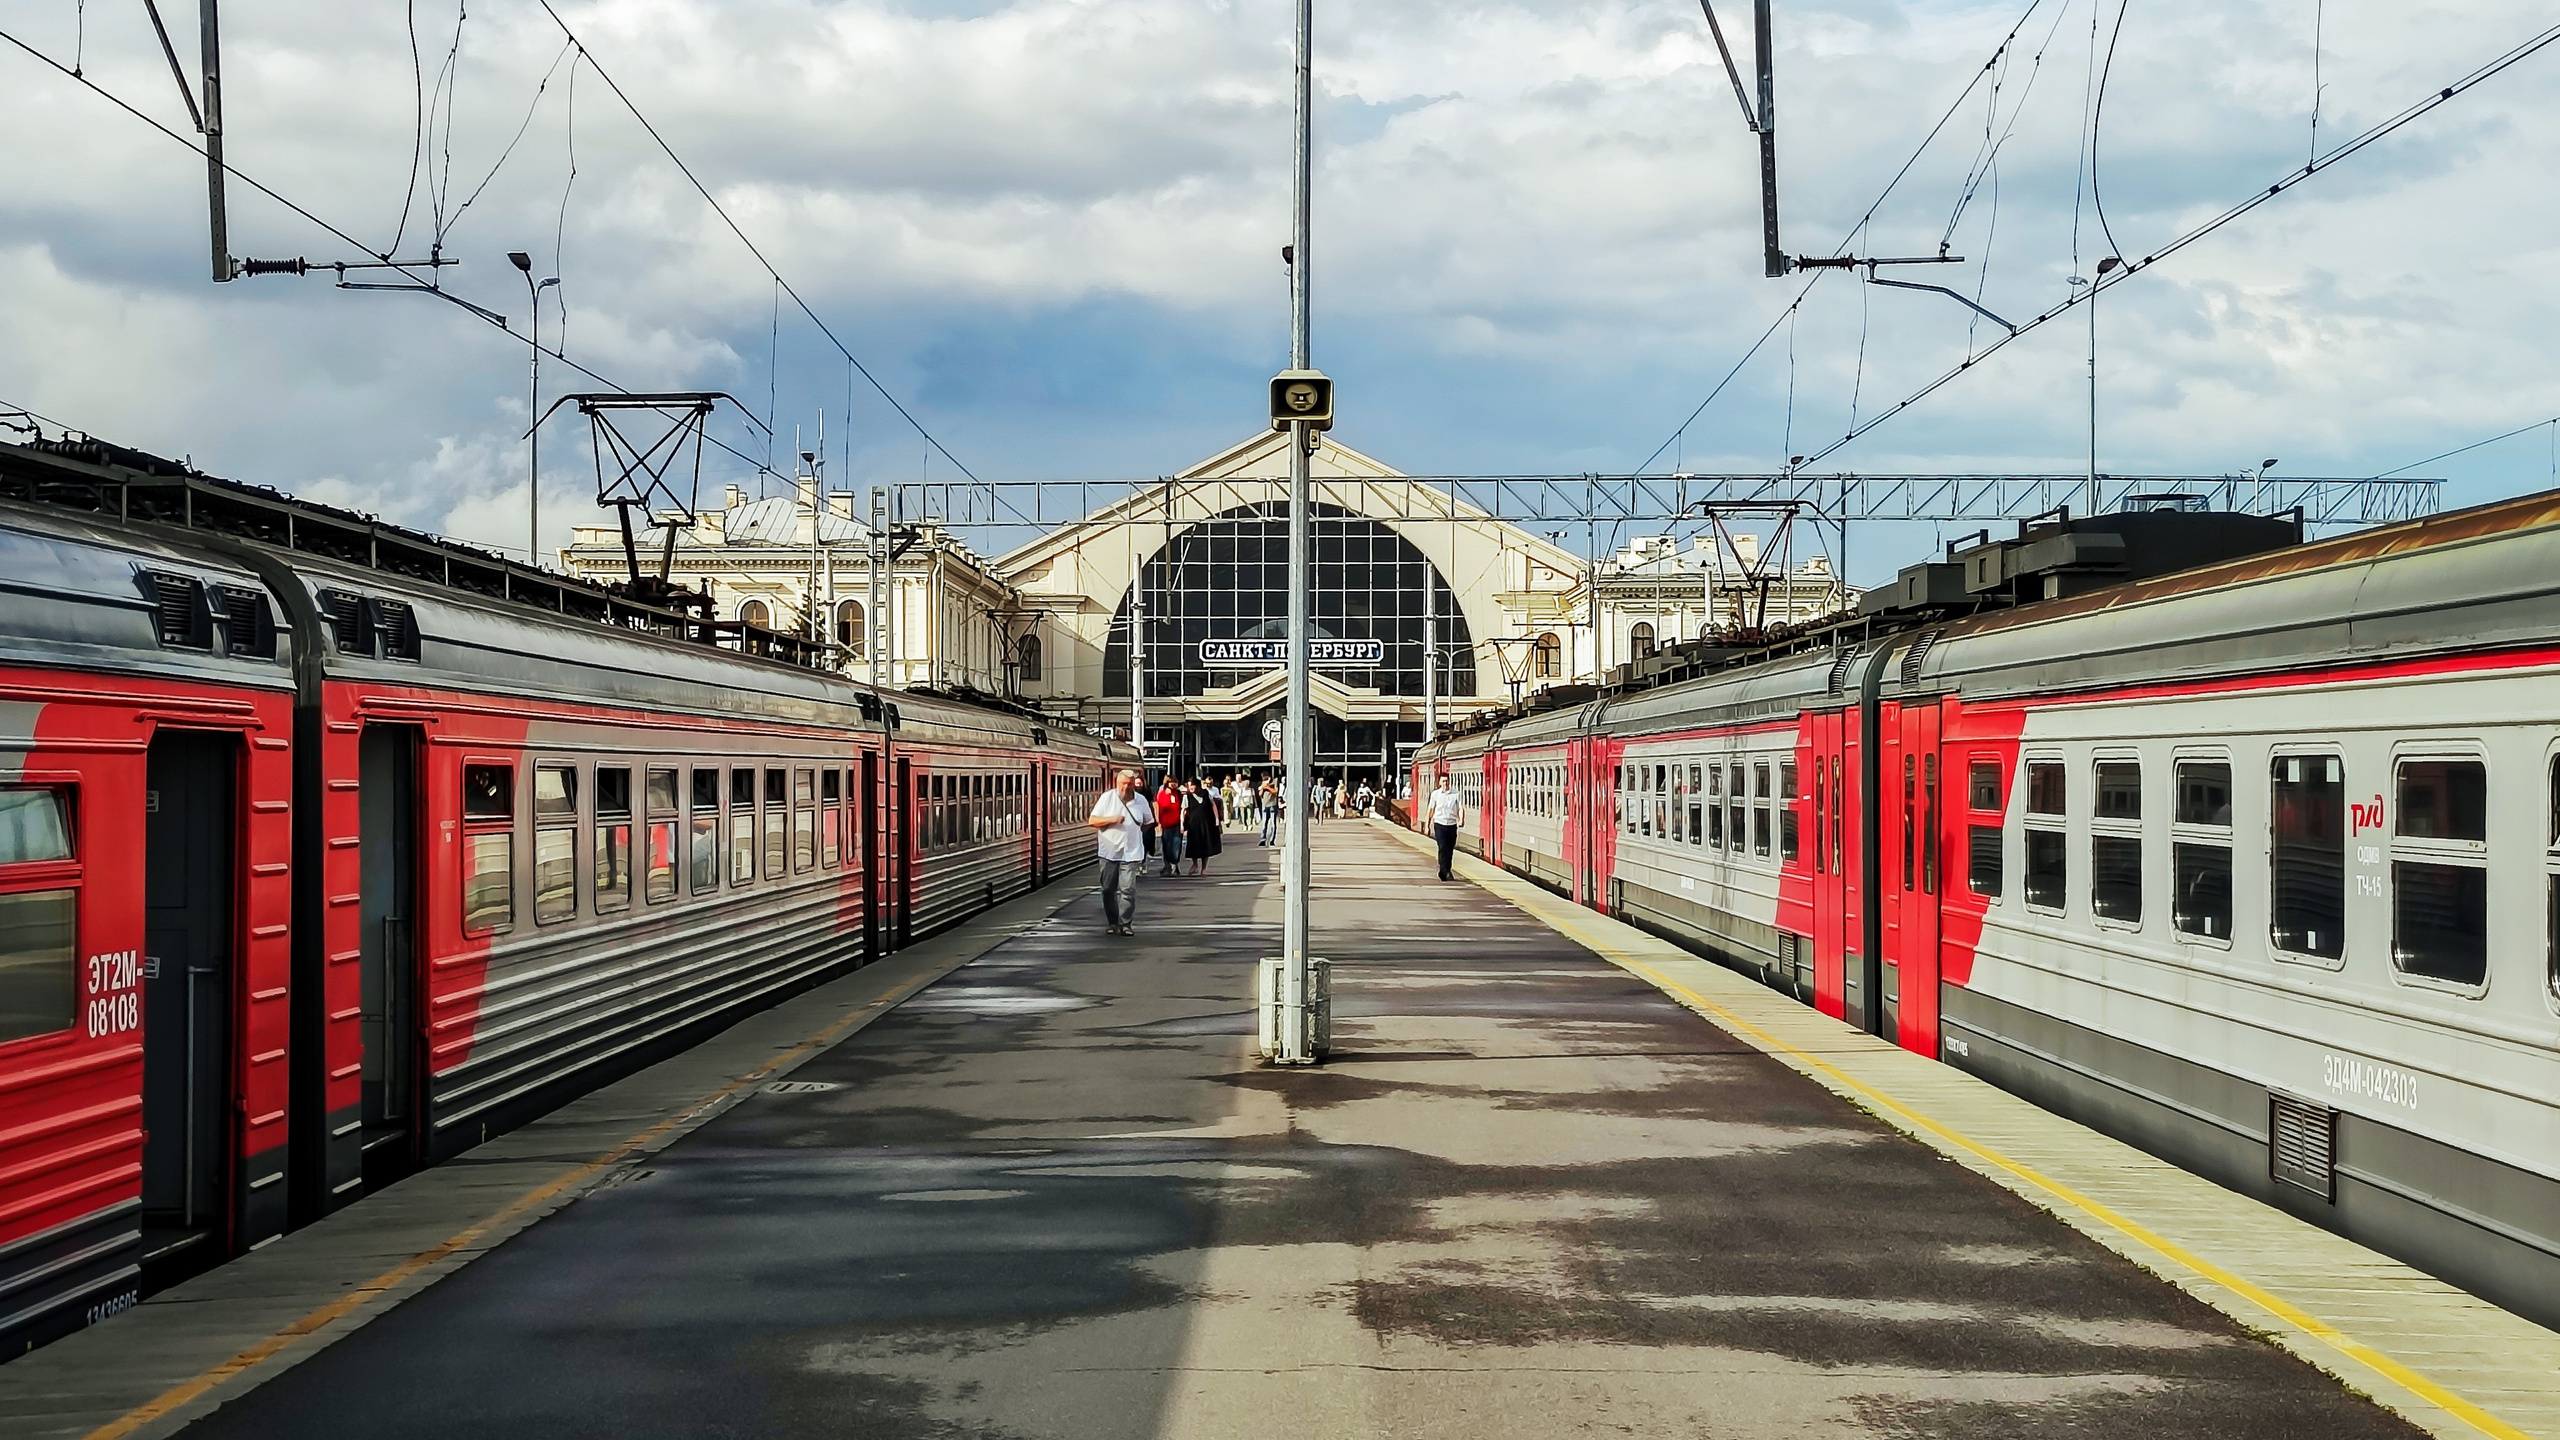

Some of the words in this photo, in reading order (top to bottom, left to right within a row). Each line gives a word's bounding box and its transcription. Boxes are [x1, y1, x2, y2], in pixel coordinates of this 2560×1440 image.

[1205, 643, 1378, 658] САНКТ-ПЕРБУРГ
[2356, 875, 2382, 897] ТЧ-15
[88, 950, 144, 994] ЭТ2М-
[88, 992, 138, 1039] 08108
[2324, 1054, 2418, 1110] ЭД4М-042303
